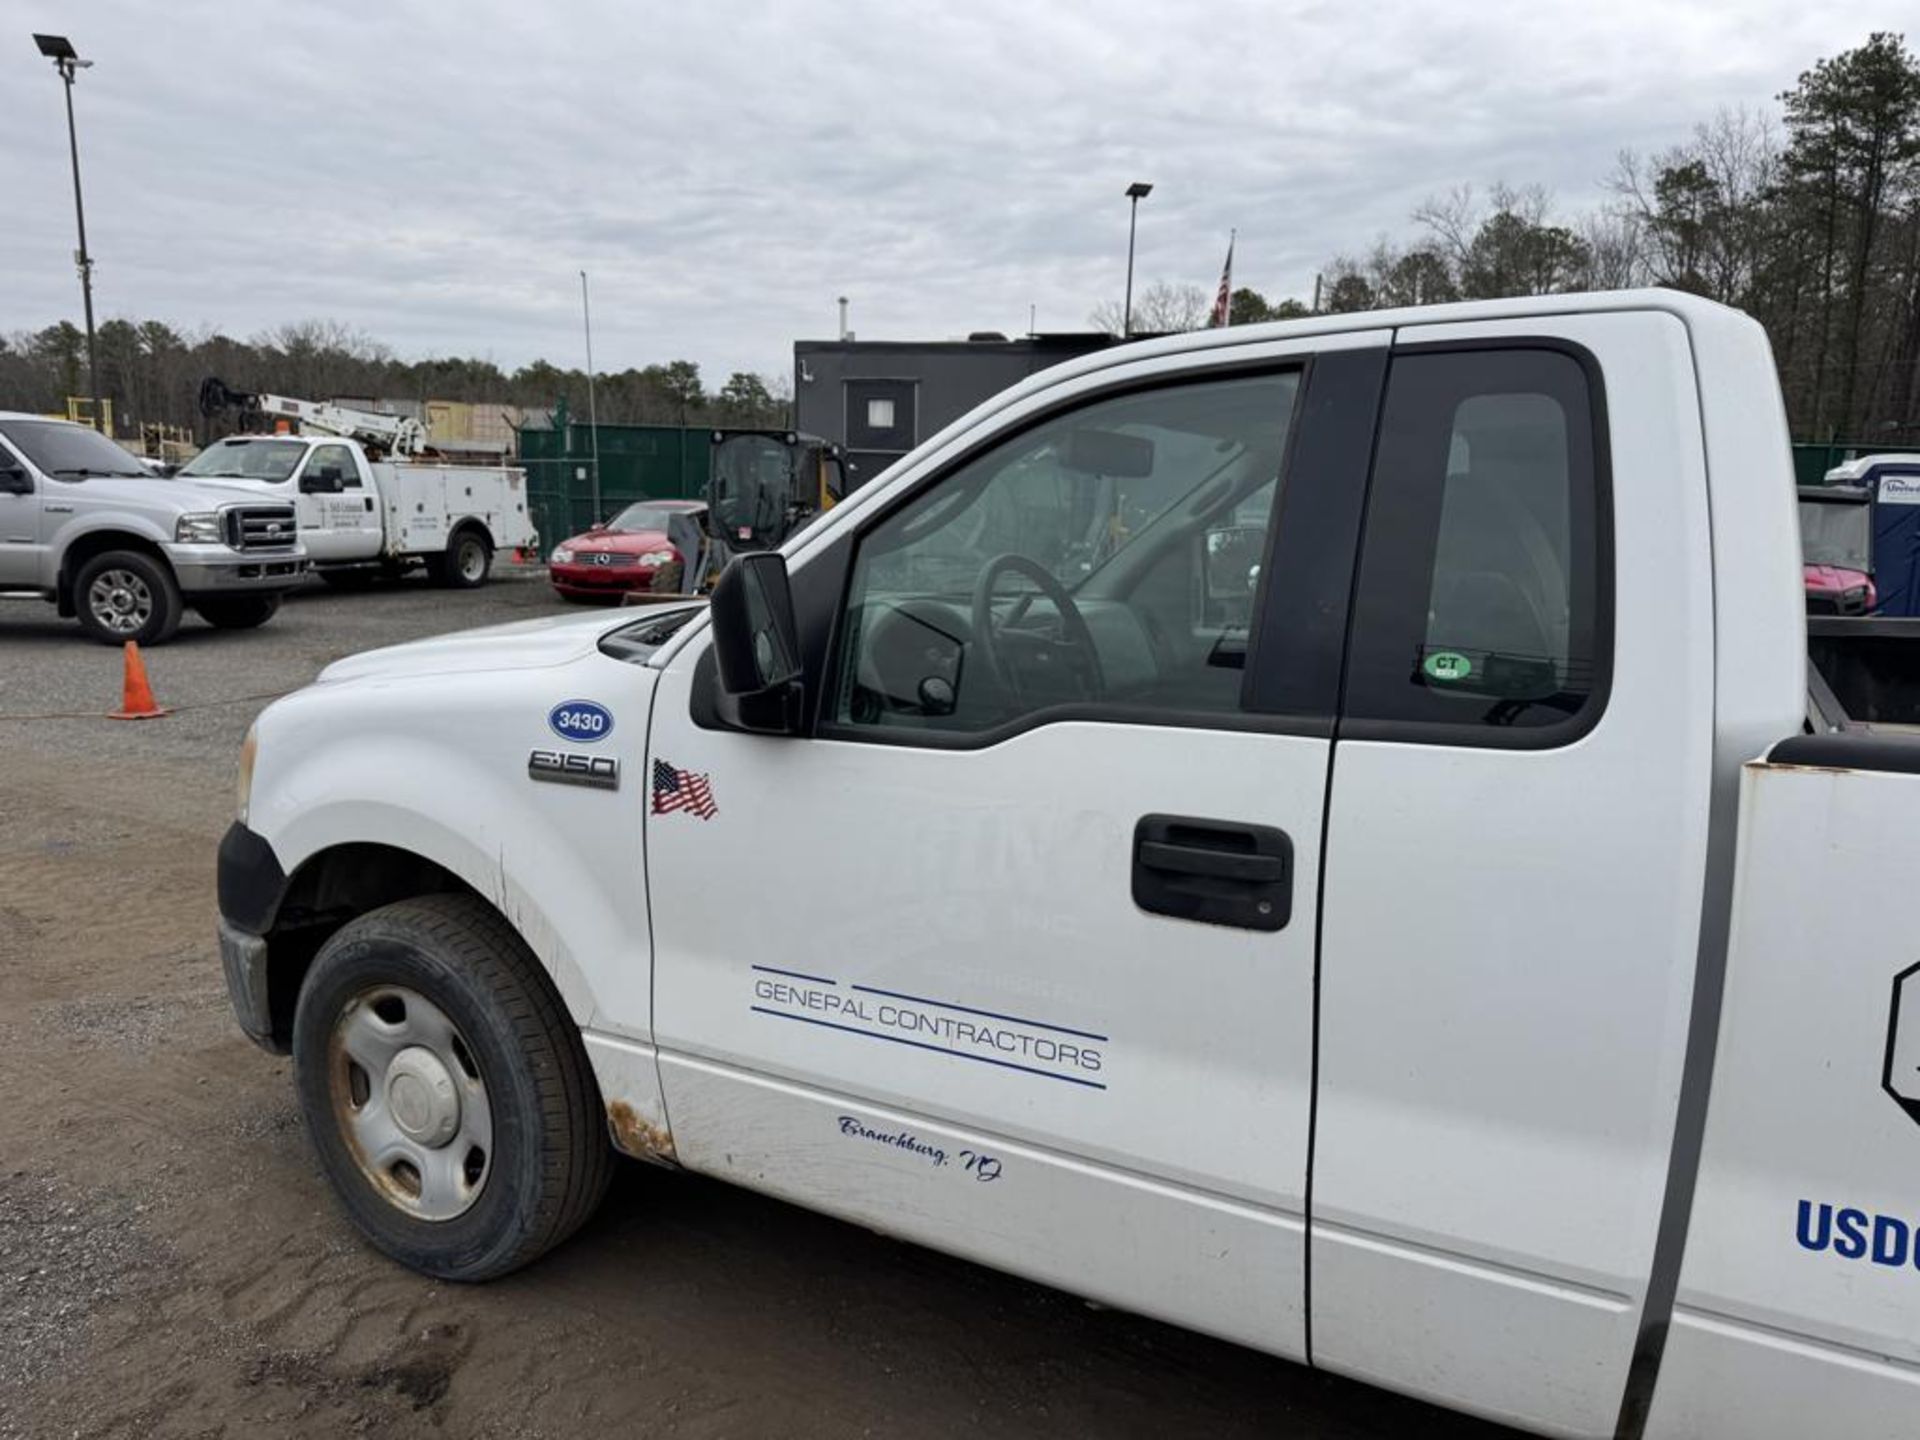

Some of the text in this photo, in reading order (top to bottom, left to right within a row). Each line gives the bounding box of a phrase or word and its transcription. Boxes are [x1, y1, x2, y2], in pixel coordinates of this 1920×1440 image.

[1436, 656, 1459, 669] CT
[558, 711, 604, 732] 3430
[755, 979, 873, 1021] GENERAL
[879, 1005, 1102, 1071] CONTRACTORS
[837, 1116, 948, 1166] Branchburg,
[1796, 1199, 1920, 1272] USD
